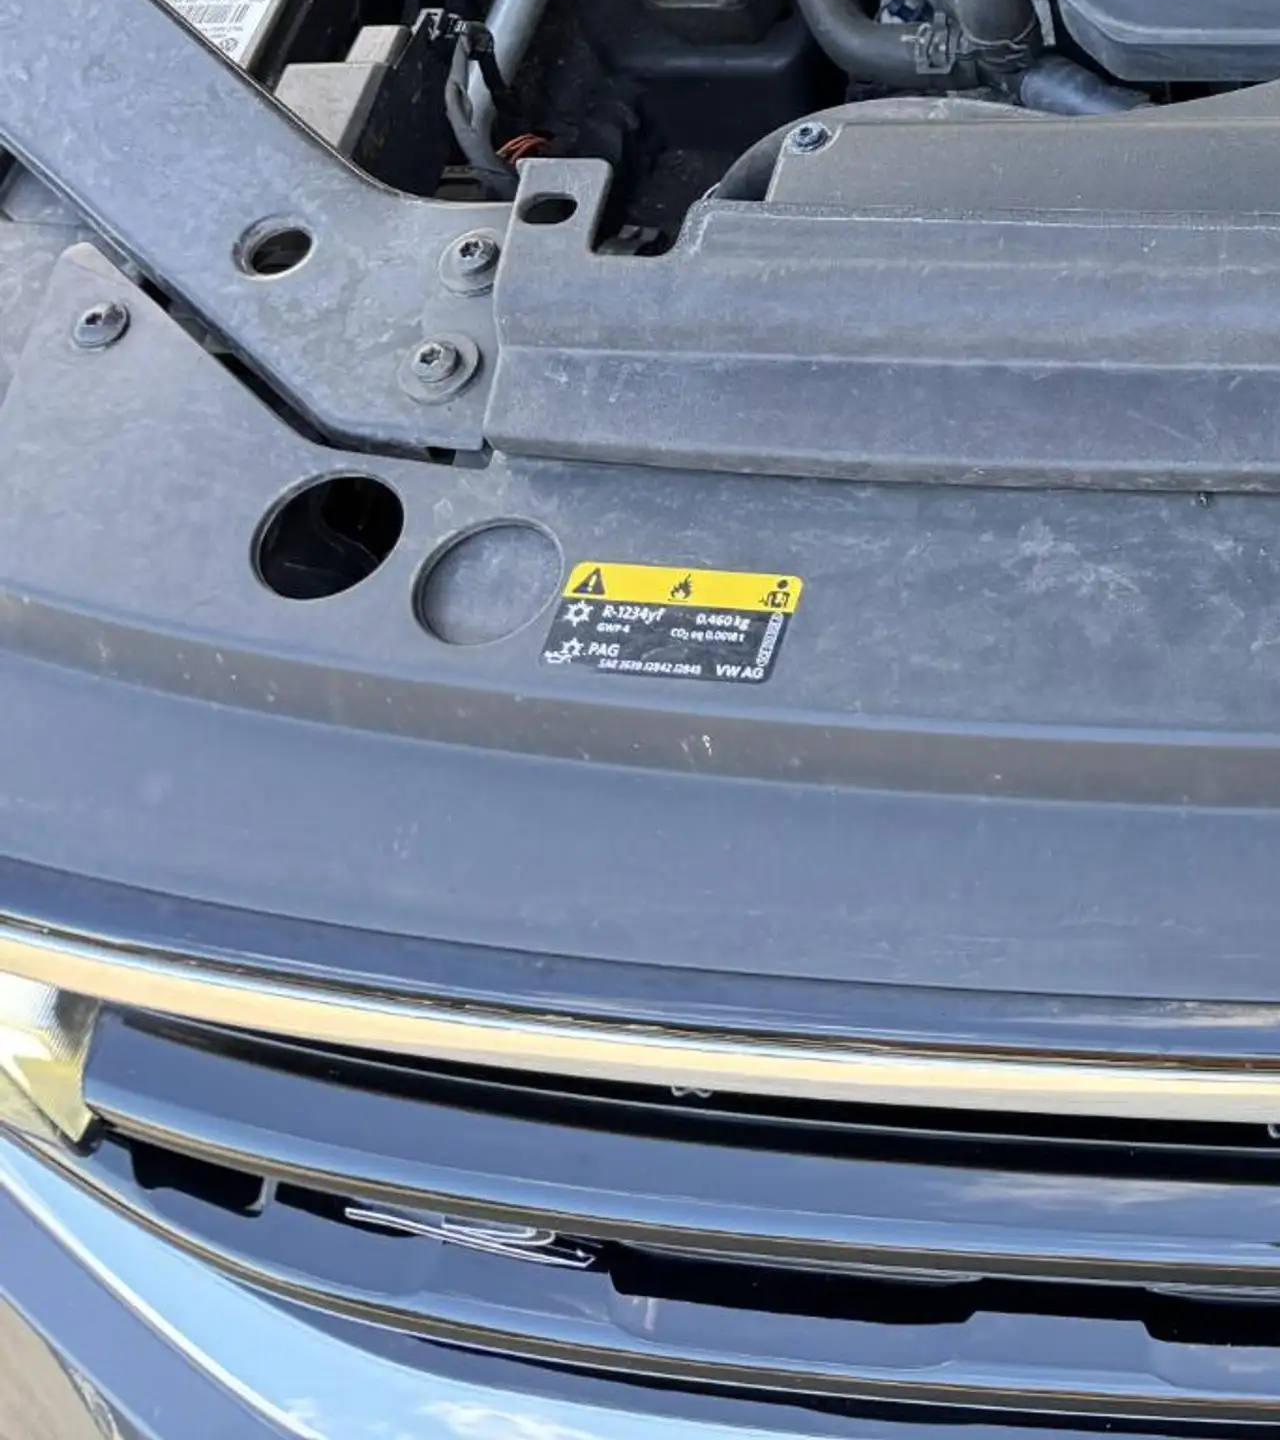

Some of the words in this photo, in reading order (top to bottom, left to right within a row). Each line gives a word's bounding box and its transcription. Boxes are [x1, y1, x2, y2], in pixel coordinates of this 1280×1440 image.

[602, 604, 667, 625] R-1234yf
[588, 642, 620, 657] PAG
[715, 663, 742, 678] VW
[741, 666, 765, 679] AG
